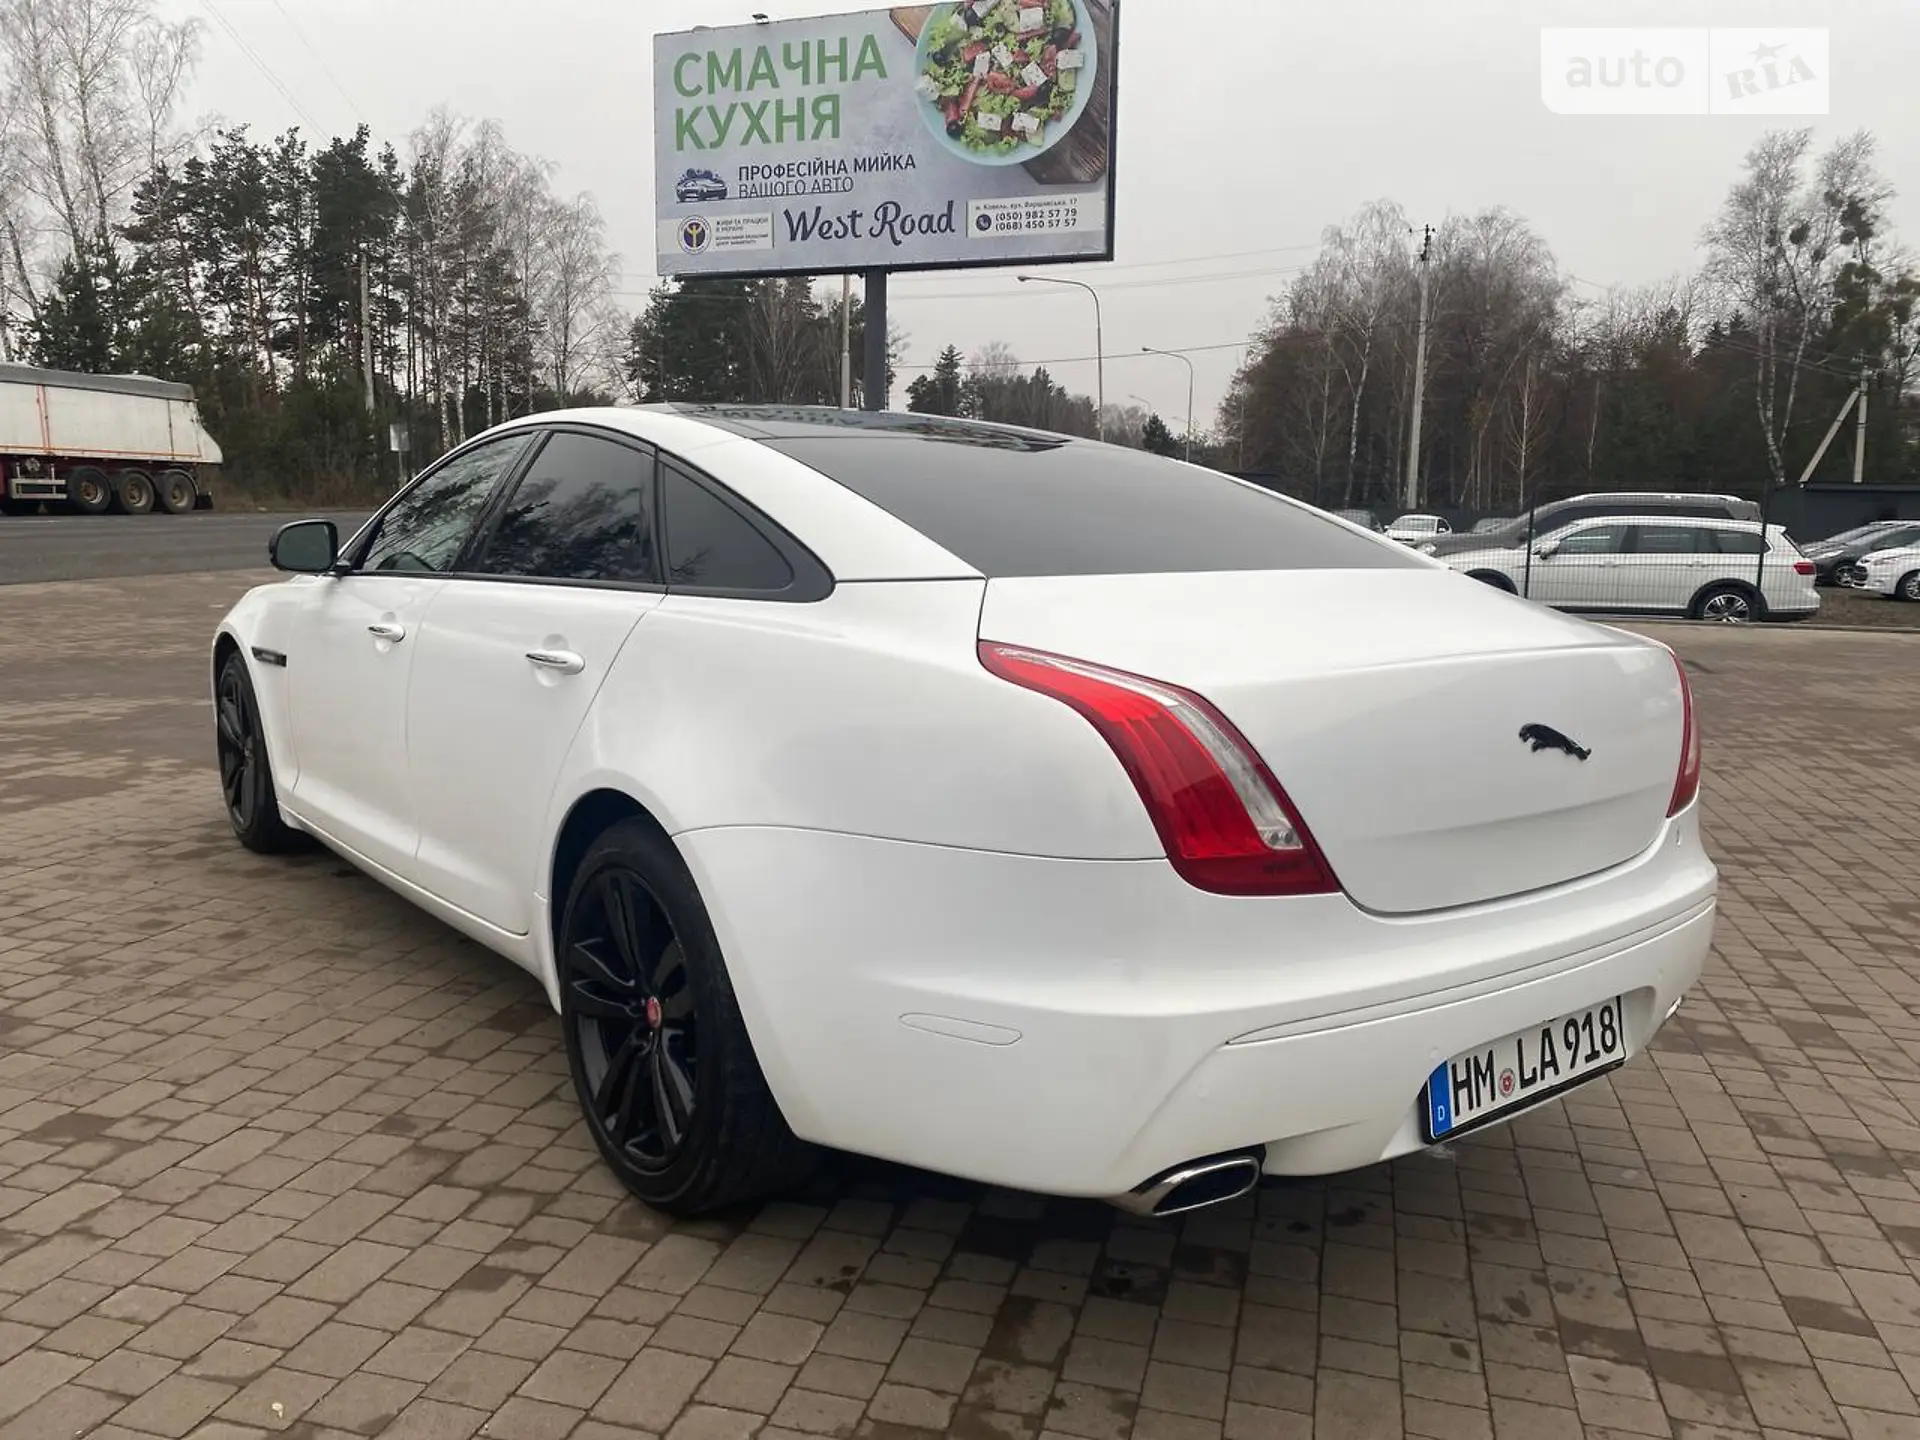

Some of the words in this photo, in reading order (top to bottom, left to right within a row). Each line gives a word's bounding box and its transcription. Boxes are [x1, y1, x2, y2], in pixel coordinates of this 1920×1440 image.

[673, 33, 889, 98] СМАЧНА
[675, 94, 841, 151] КУХНЯ
[739, 156, 849, 181] ПРОФЕСІЙНА
[854, 153, 916, 173] МИЙКА
[739, 179, 806, 199] ВАШОГО
[811, 176, 854, 194] АВТО
[783, 205, 863, 242] West
[869, 200, 956, 246] Road
[995, 212, 1022, 221] (050)
[1025, 210, 1044, 219] 982
[1048, 209, 1060, 218] 57
[1064, 208, 1077, 217] 79
[995, 222, 1022, 231] (068)
[1025, 220, 1045, 229] 450
[1048, 219, 1060, 228] 57
[1064, 218, 1077, 227] 57
[1437, 1105, 1446, 1122] D
[1452, 1050, 1496, 1116] HM
[1517, 1027, 1560, 1089] LA
[1563, 1004, 1616, 1070] 918
